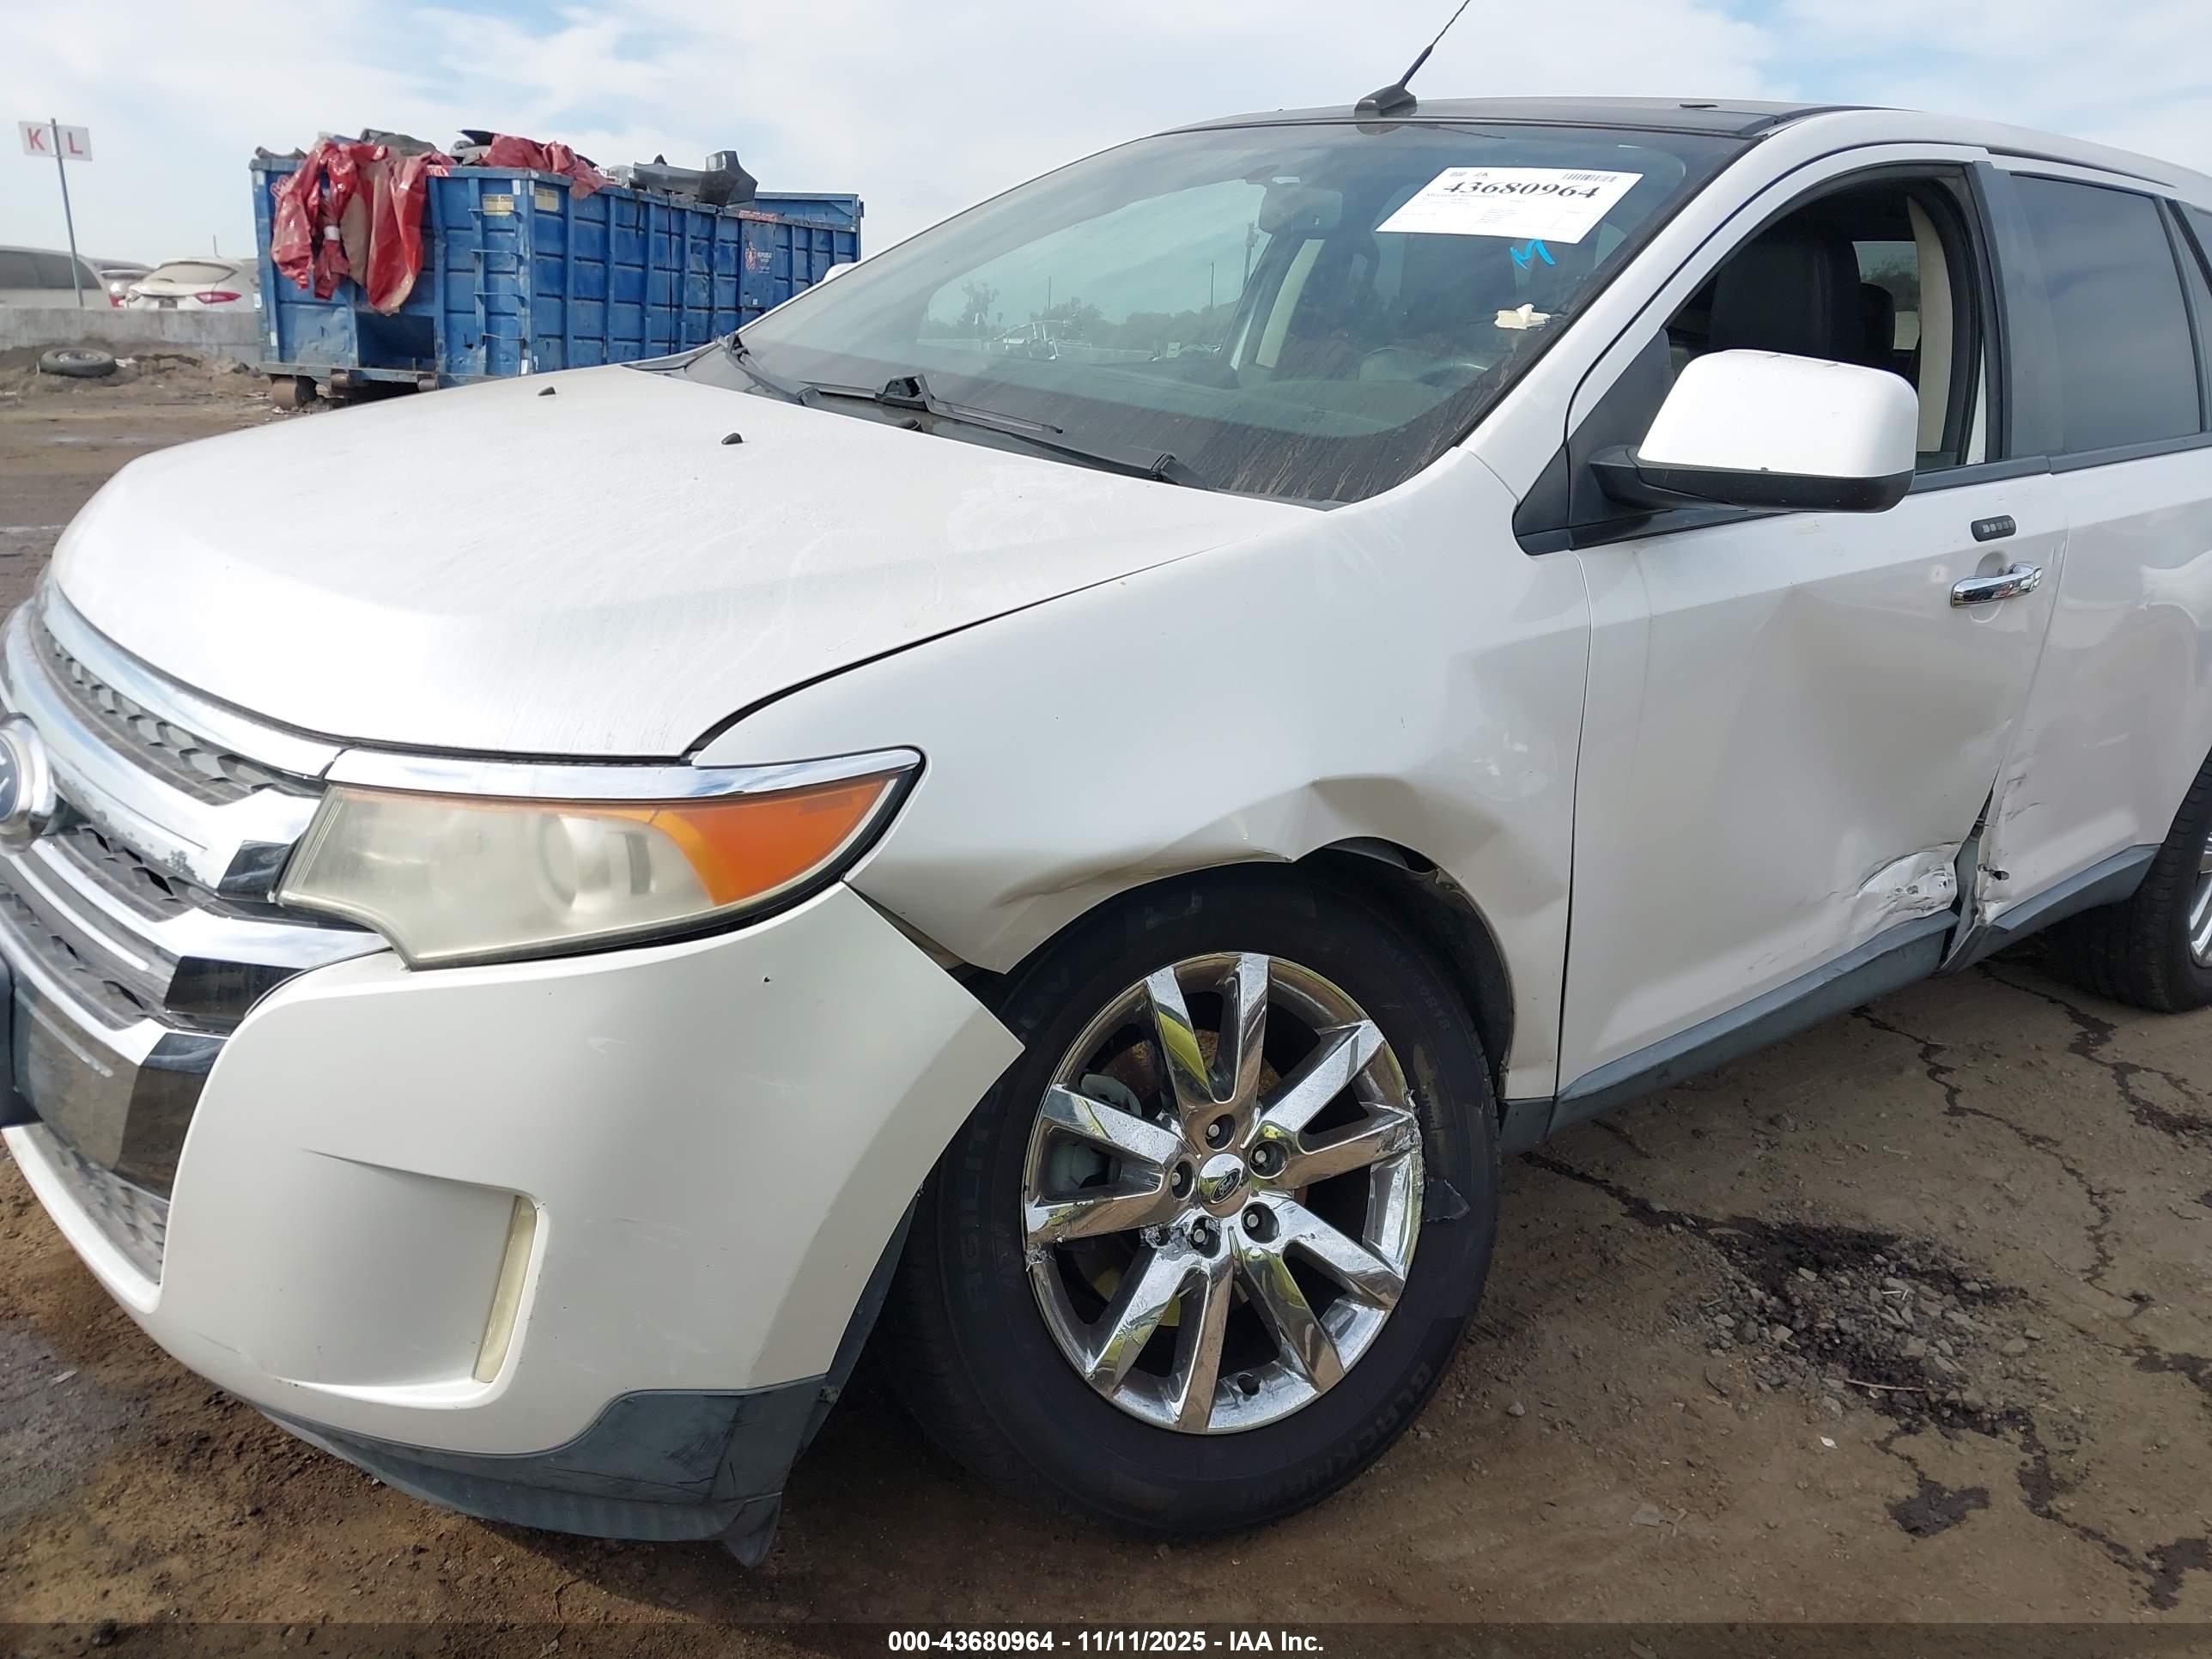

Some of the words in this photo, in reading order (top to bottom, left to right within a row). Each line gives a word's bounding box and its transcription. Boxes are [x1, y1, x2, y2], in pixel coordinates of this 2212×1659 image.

[27, 128, 45, 151] K
[68, 131, 83, 155] L
[1443, 180, 1600, 198] 43680964
